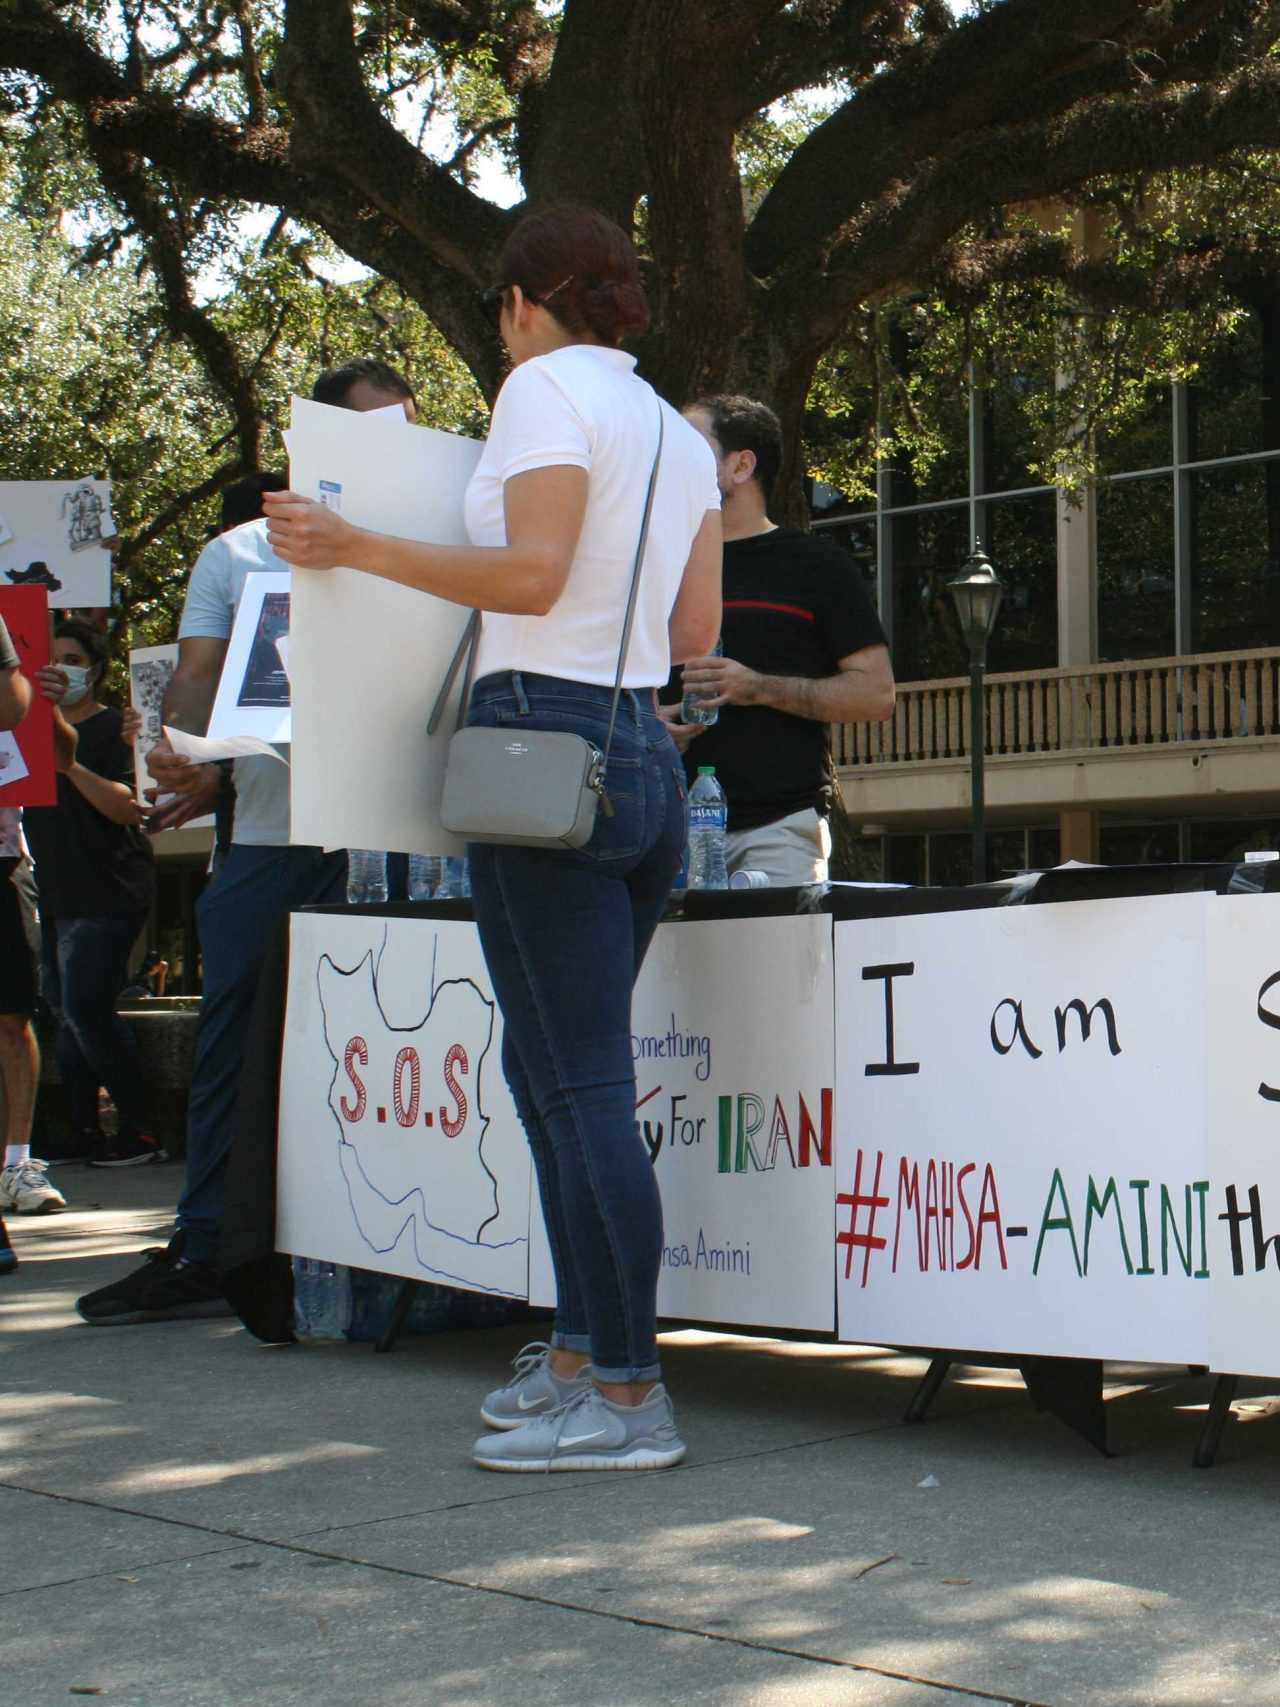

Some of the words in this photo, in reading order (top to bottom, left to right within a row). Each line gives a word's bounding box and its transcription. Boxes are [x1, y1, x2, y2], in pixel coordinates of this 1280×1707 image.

[631, 1011, 711, 1081] omething
[861, 962, 920, 1076] I
[990, 998, 1122, 1059] am
[340, 1036, 468, 1137] S.O.S
[670, 1094, 707, 1146] For
[718, 1088, 833, 1173] IRAN
[695, 1227, 750, 1275] Amini
